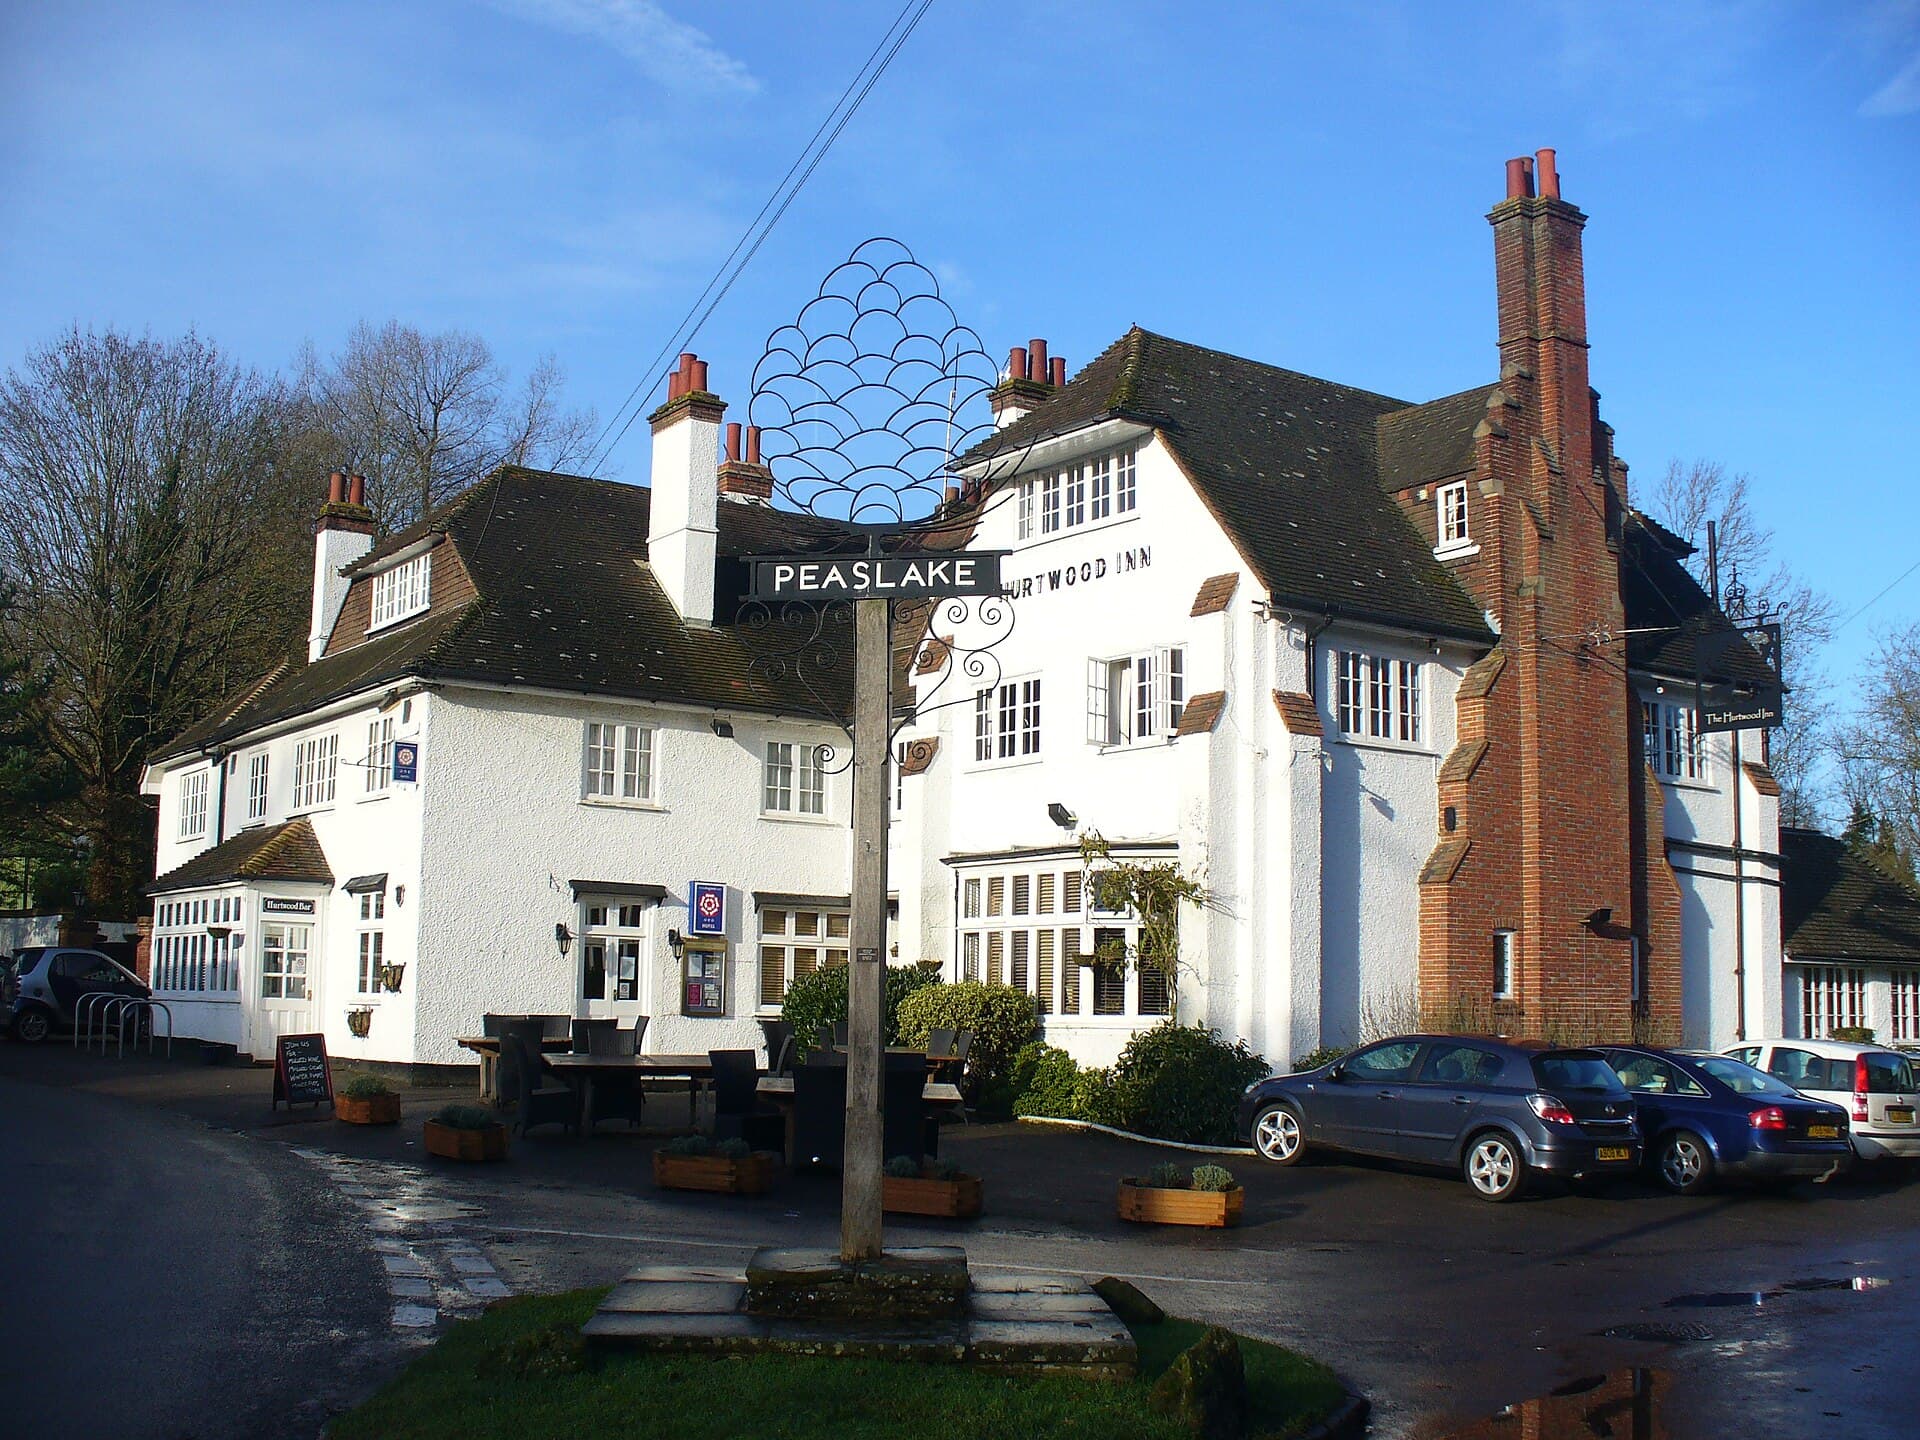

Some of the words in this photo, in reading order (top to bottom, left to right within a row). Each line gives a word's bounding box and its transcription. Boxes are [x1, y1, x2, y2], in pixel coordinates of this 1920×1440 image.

[1116, 546, 1151, 573] INN
[774, 560, 976, 592] PEASLAKE
[1705, 713, 1722, 725] The
[1723, 708, 1761, 723] Hurtwood
[1762, 708, 1774, 719] Inn
[267, 900, 299, 910] Hurtwood
[299, 902, 312, 911] Bar
